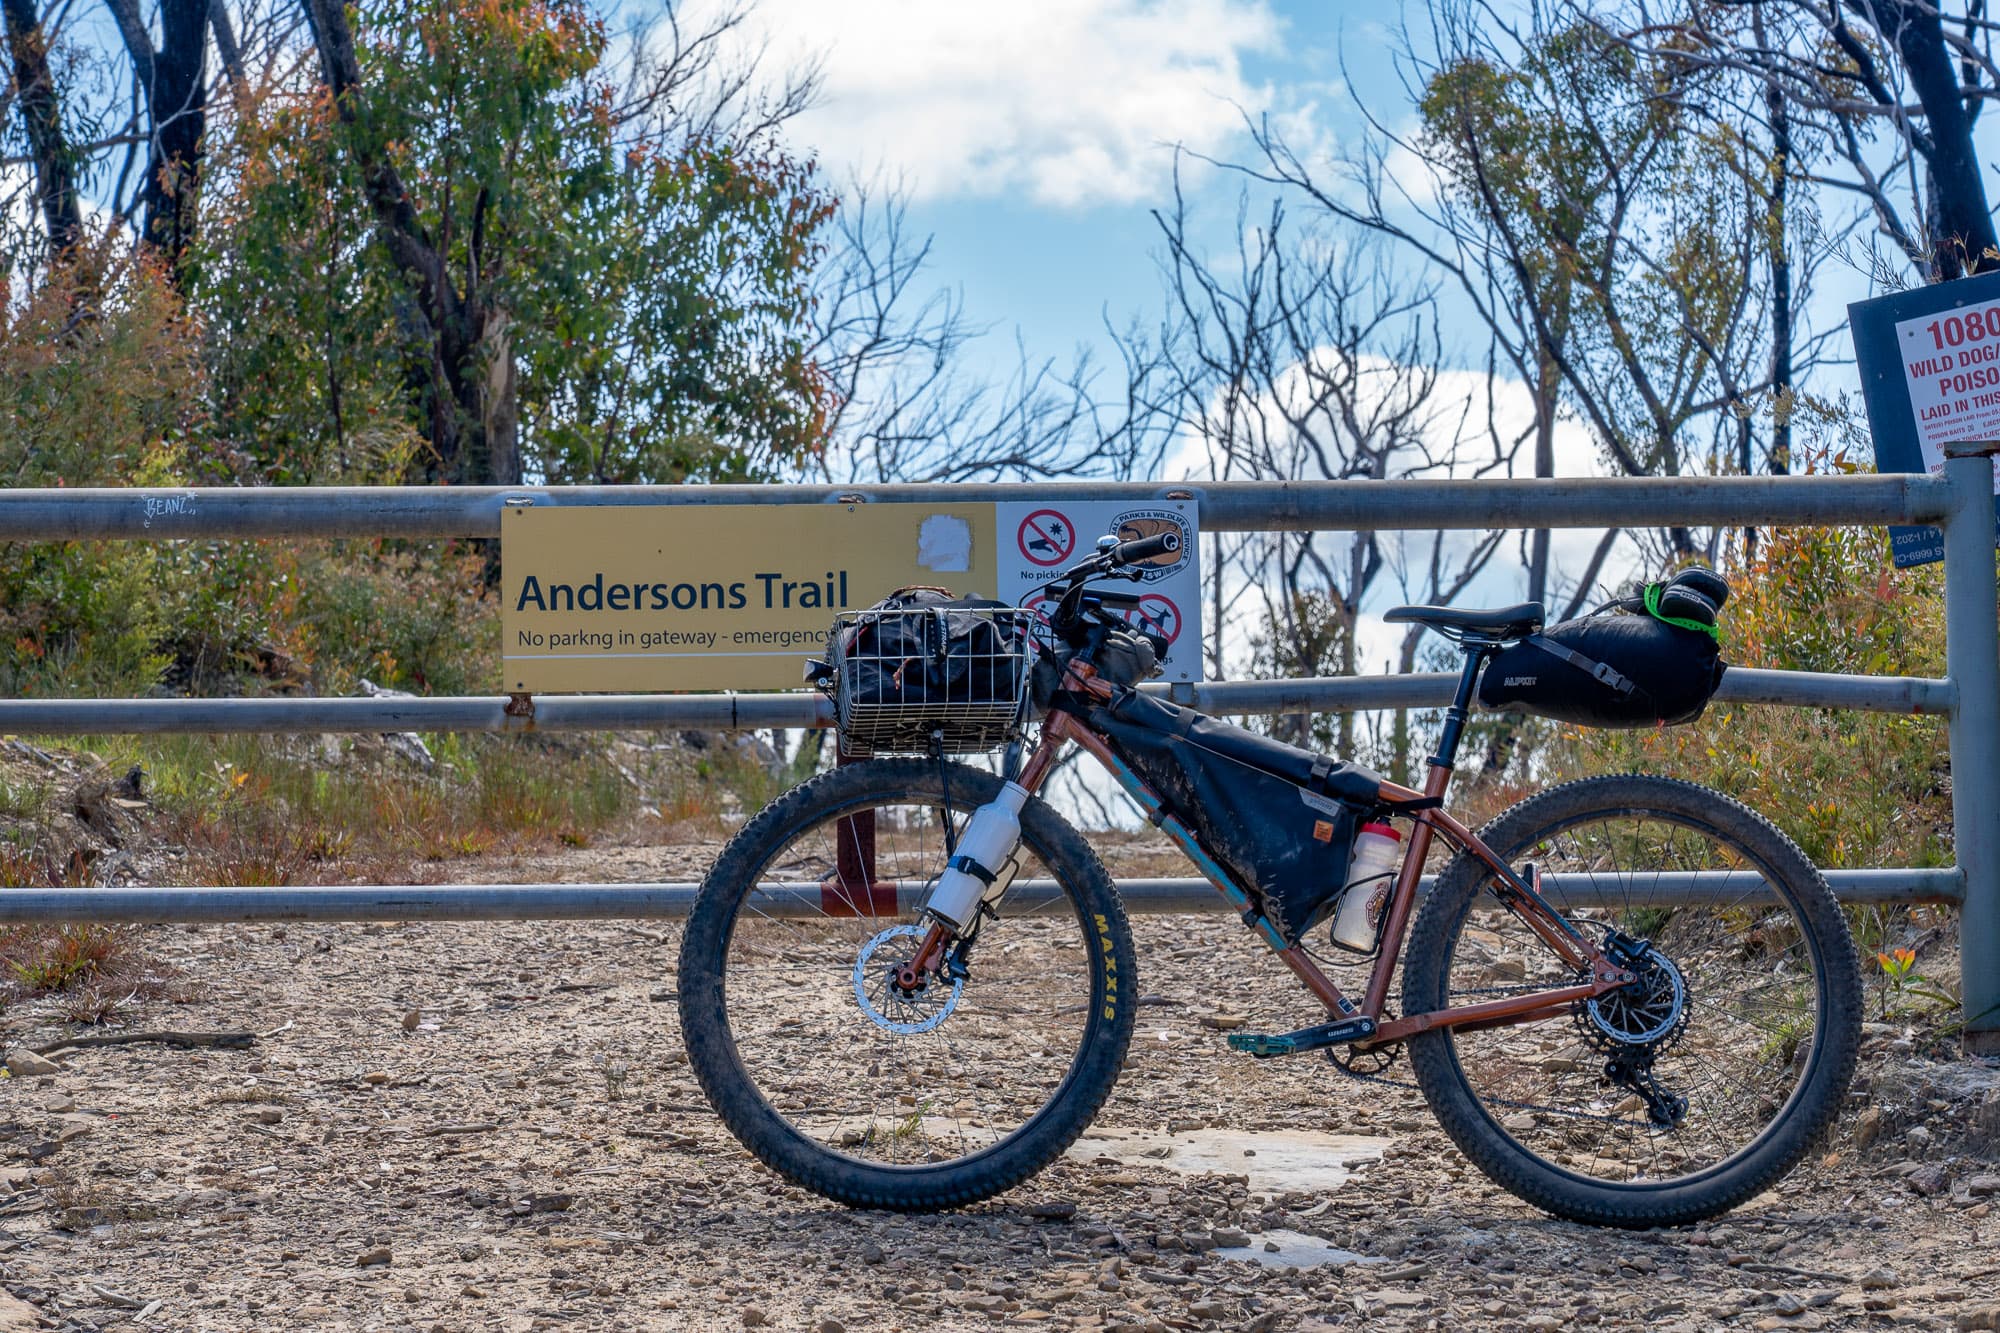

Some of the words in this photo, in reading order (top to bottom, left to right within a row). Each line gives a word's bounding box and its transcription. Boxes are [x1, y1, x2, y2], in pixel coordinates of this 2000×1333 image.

[1927, 307, 2000, 350] 1080
[1909, 355, 1954, 379] WILD
[1939, 365, 2000, 397] POISO
[1920, 403, 1951, 421] LAID
[1954, 399, 1969, 413] IN
[1972, 391, 2000, 409] THIS
[1119, 511, 1146, 521] PARKS
[1153, 511, 1187, 527] WILDLIFE
[1182, 527, 1190, 561] SERVICE
[516, 573, 747, 611] Andersons
[755, 570, 848, 609] Trail
[1020, 571, 1034, 580] No
[518, 630, 544, 647] No
[549, 629, 613, 649] parkng
[619, 629, 635, 645] in
[640, 630, 717, 648] gateway
[1094, 914, 1117, 1021] MAXXIS
